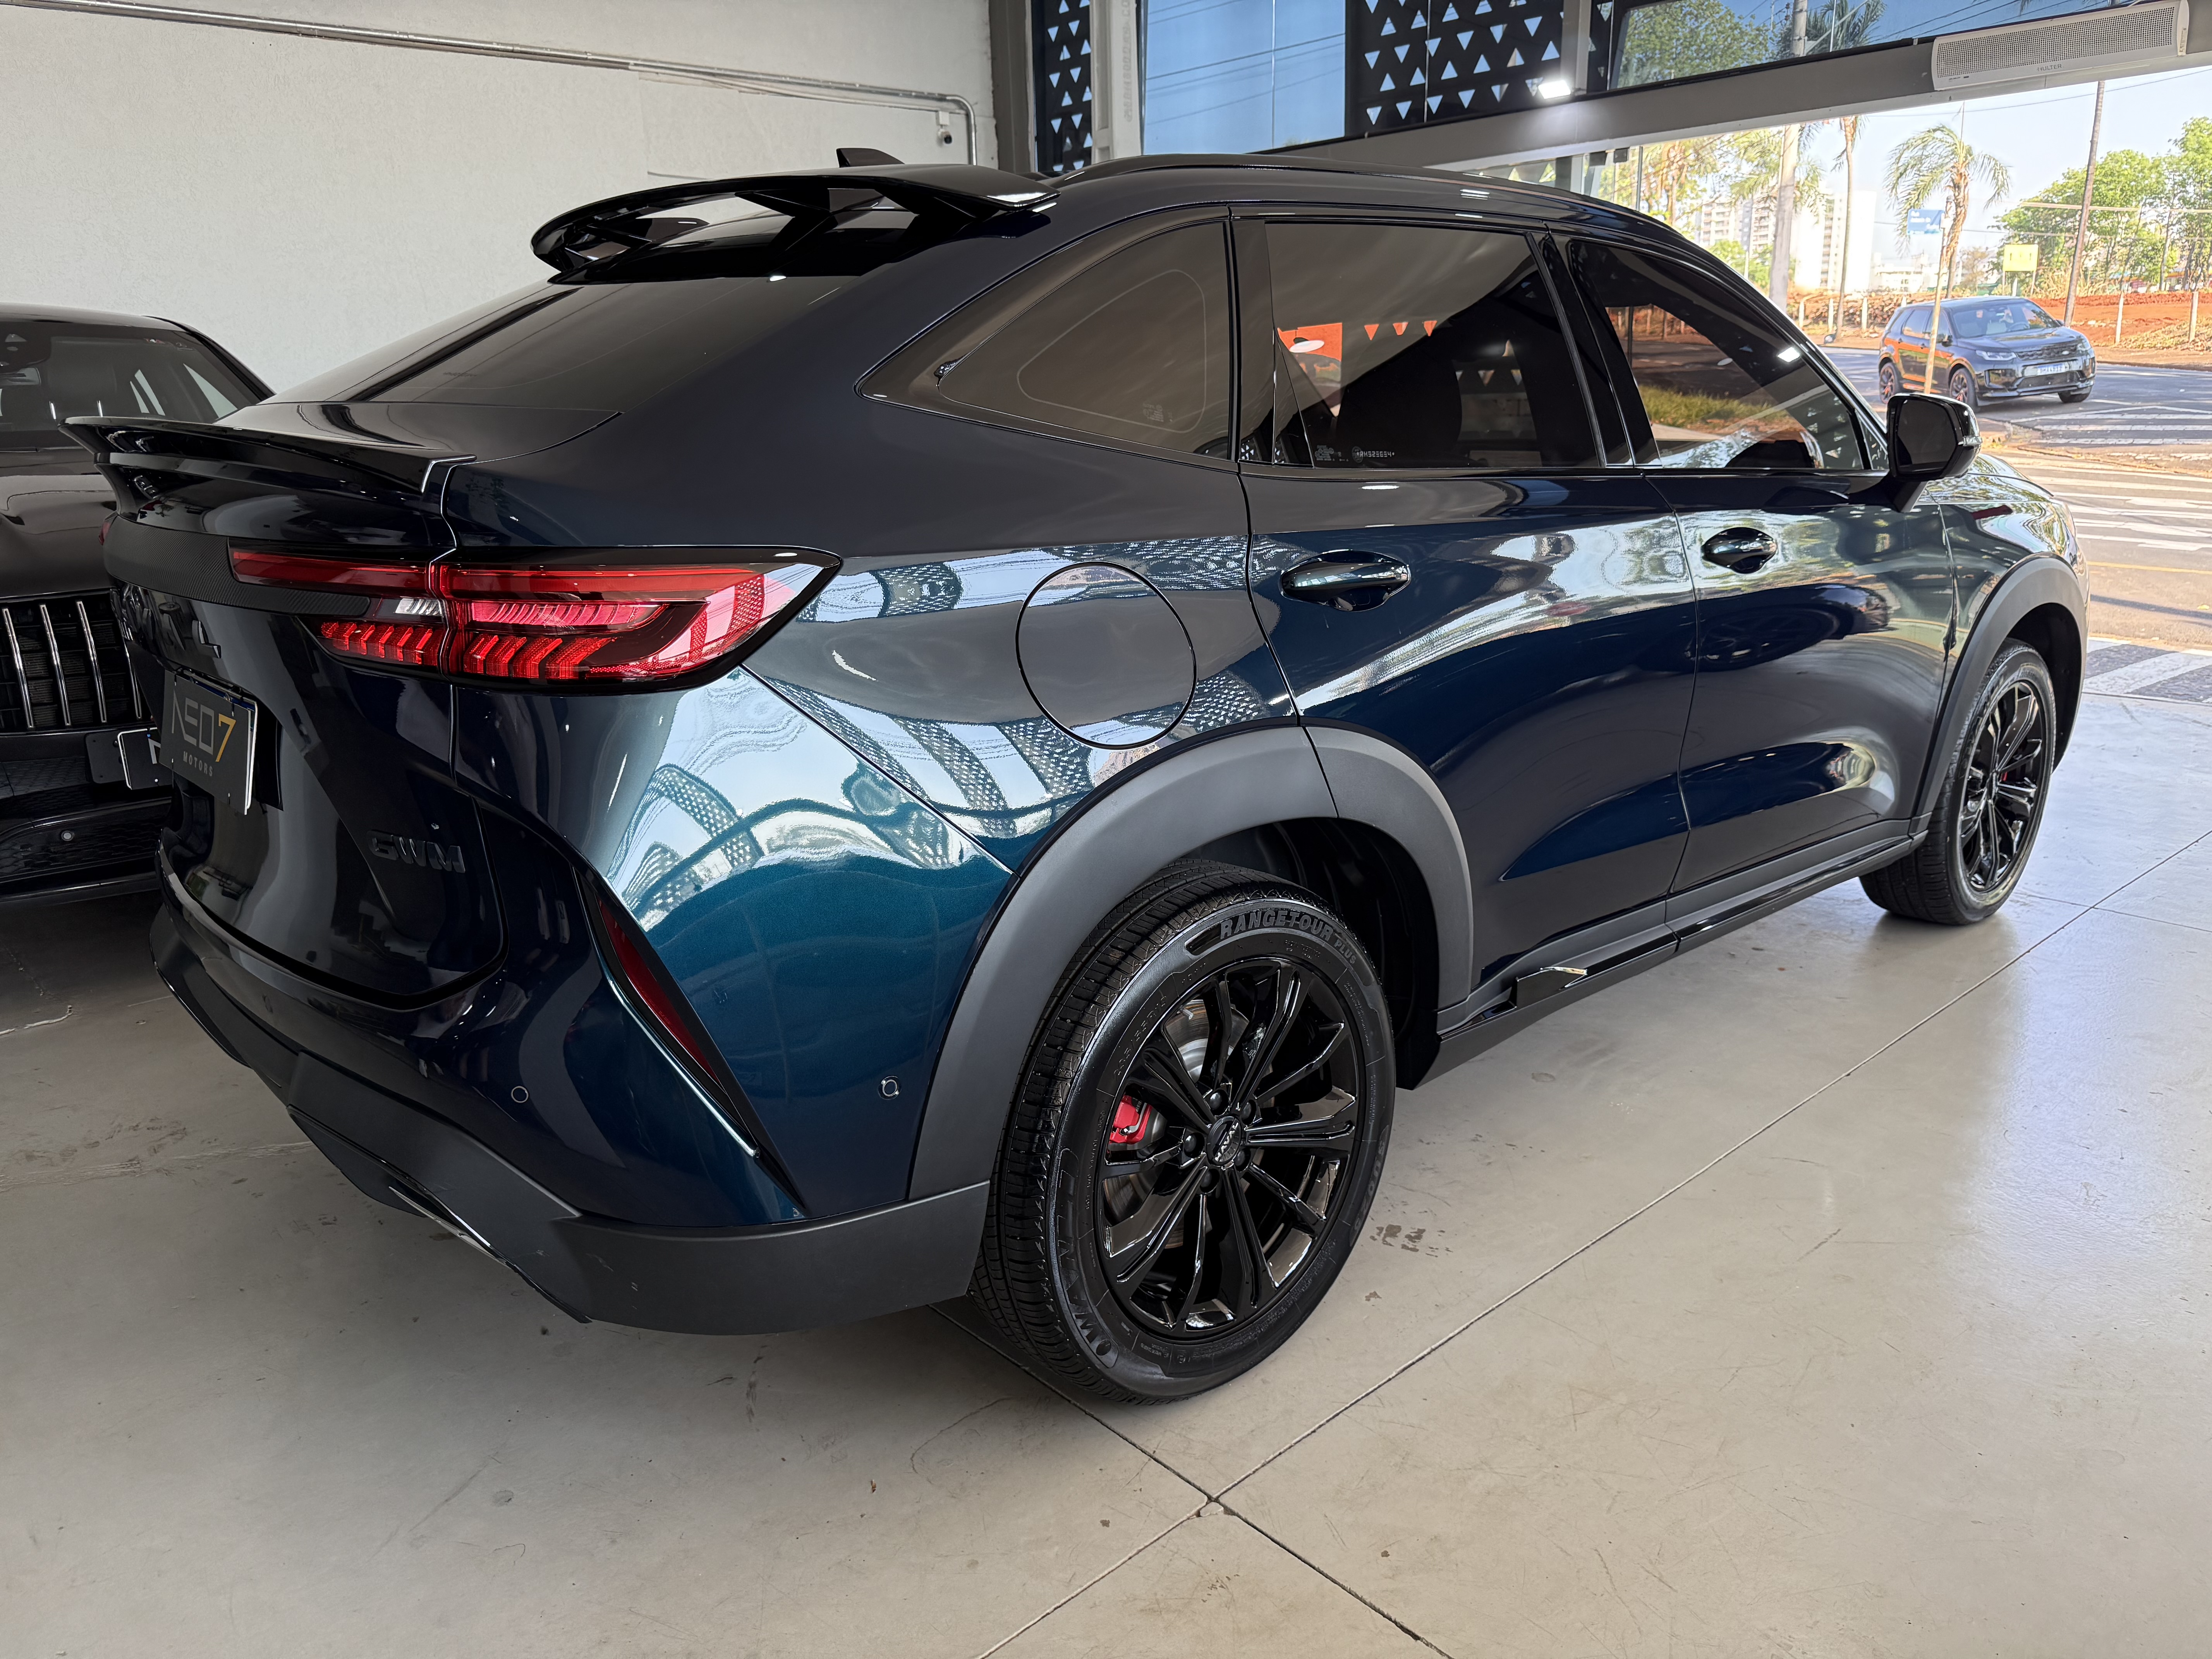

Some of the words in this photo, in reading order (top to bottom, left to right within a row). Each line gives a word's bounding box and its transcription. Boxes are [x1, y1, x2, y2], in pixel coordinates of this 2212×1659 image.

[172, 689, 236, 762] NEO7
[183, 751, 213, 777] MOTORS
[366, 830, 465, 874] GWM
[1220, 910, 1334, 941] RANGETOUR
[1334, 939, 1356, 964] PLUS
